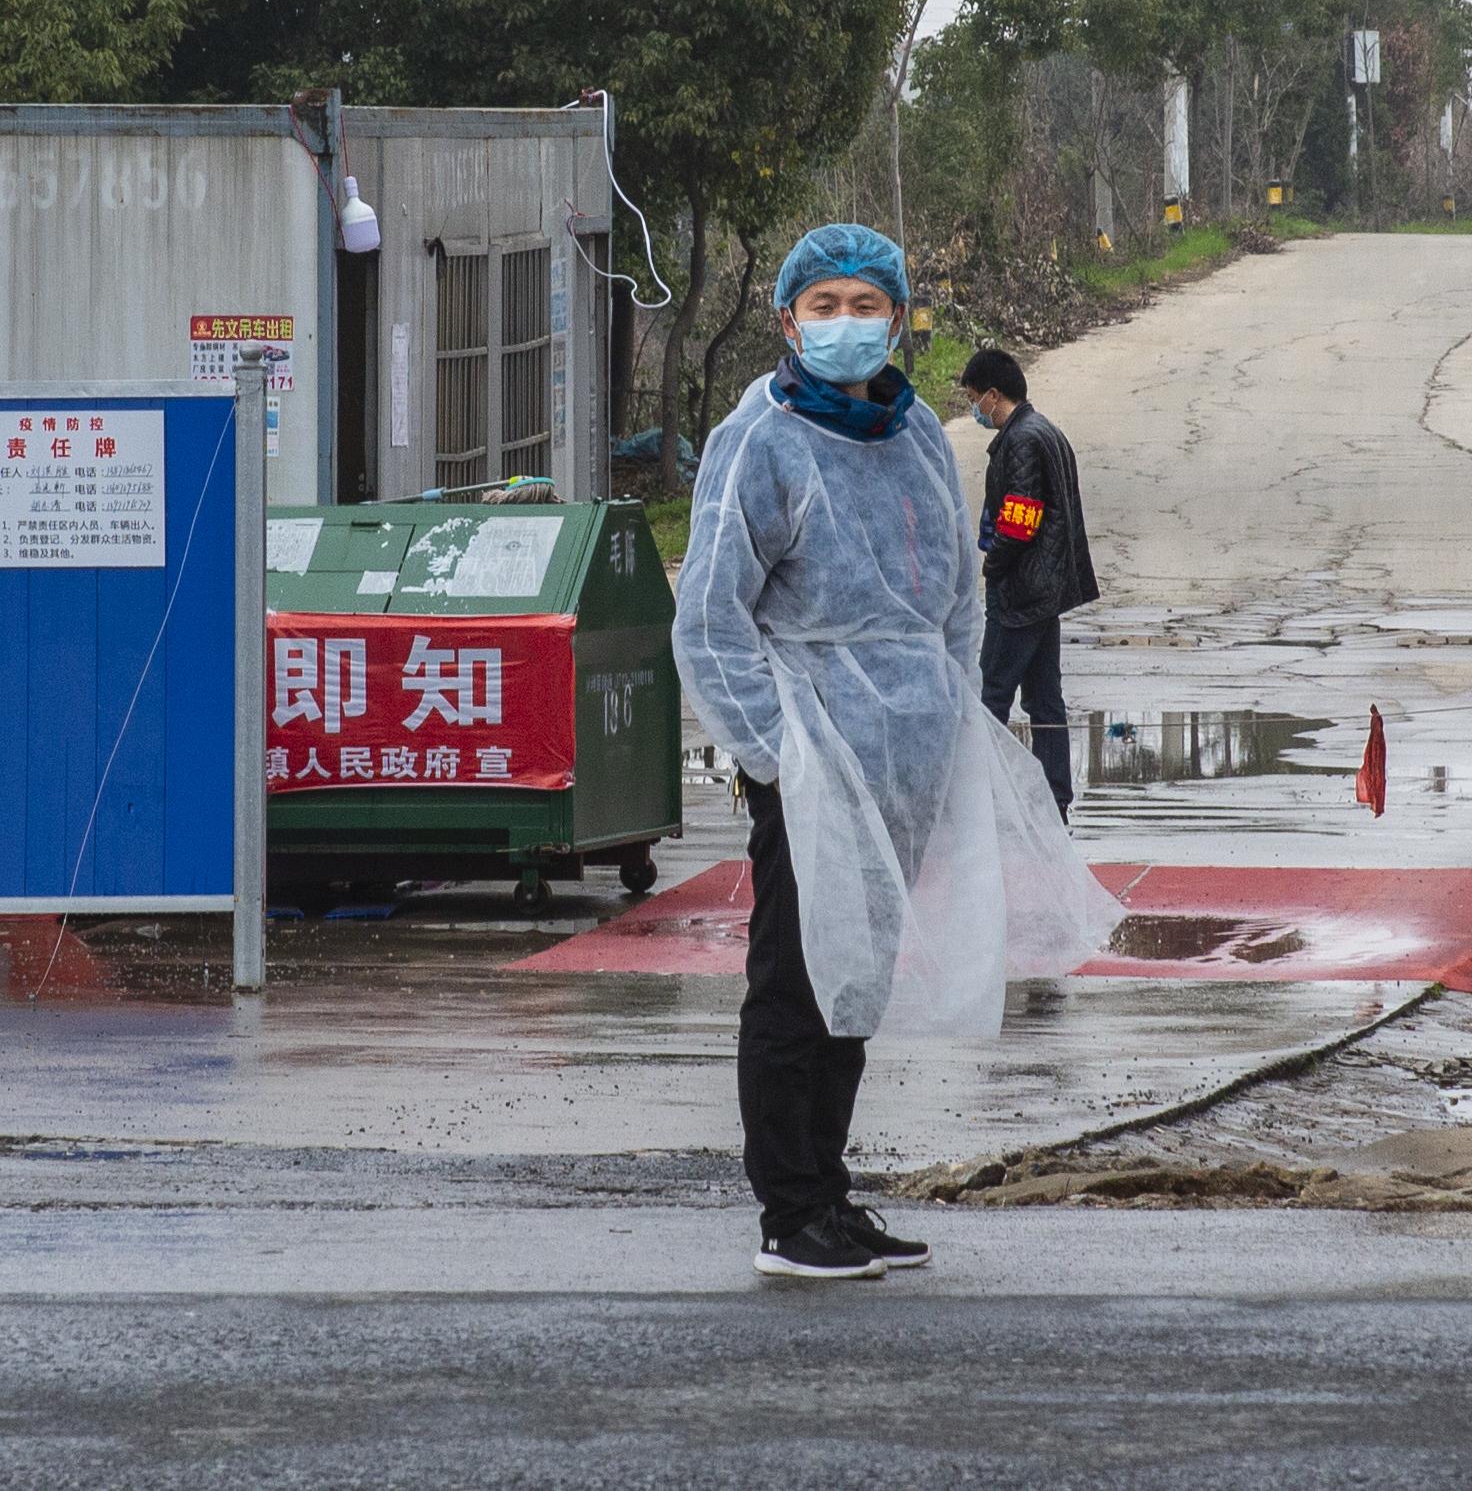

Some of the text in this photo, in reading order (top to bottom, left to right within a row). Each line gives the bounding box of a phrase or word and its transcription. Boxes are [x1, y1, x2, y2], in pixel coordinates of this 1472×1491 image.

[212, 318, 293, 339] 先文吊车出租
[19, 417, 105, 432] 疫情防控
[7, 437, 116, 459] 责任牌
[272, 634, 503, 734] 即知
[475, 745, 513, 780] 宣
